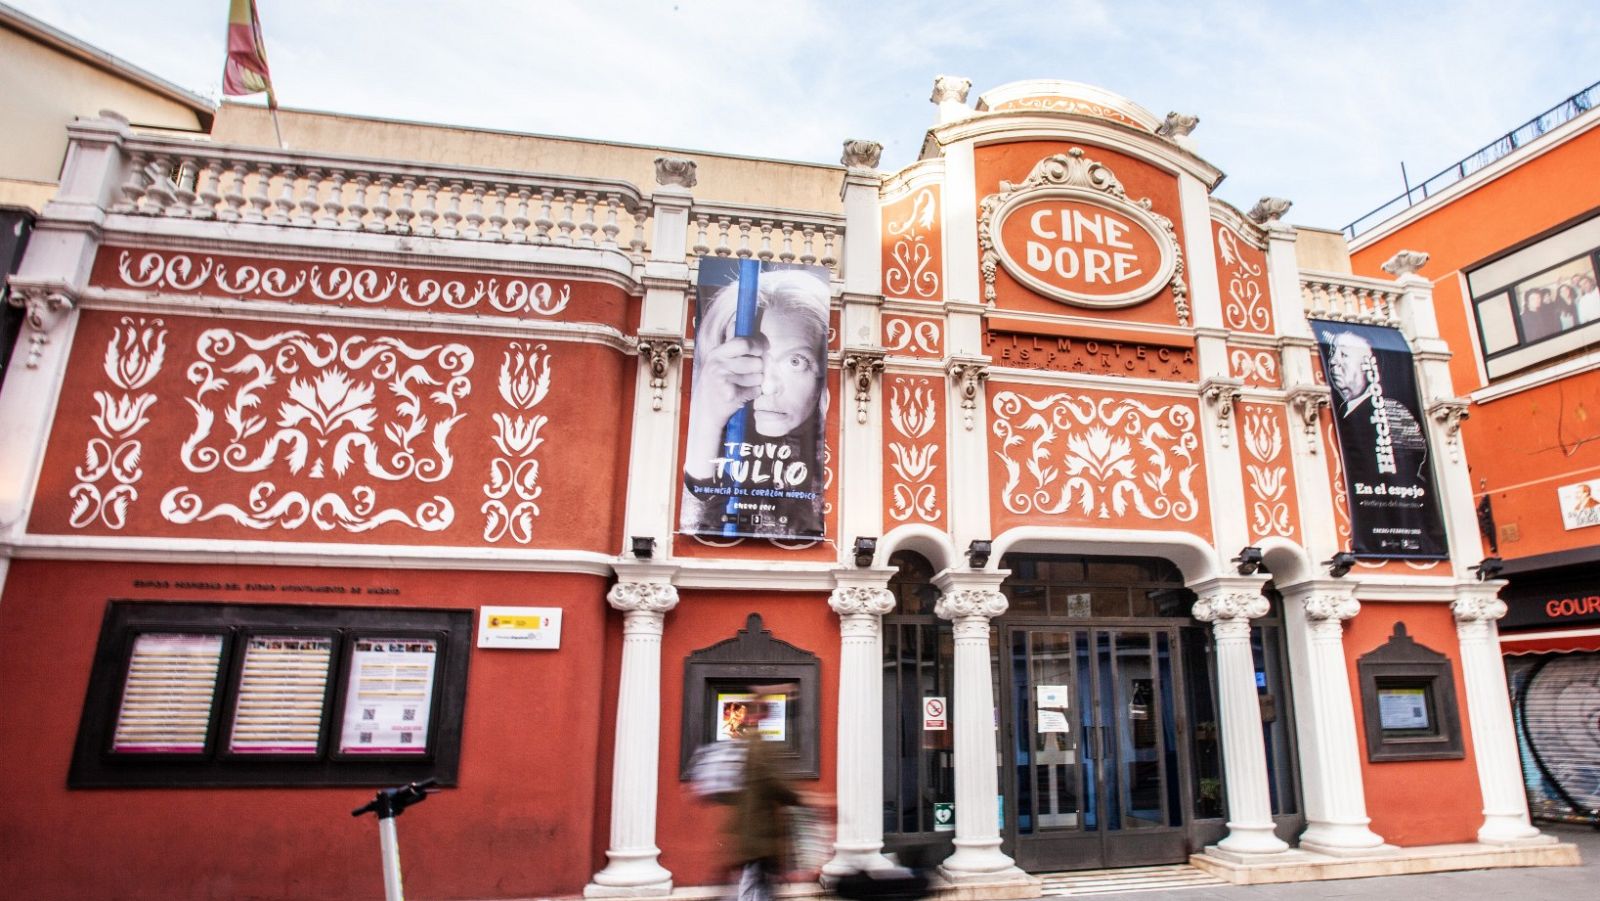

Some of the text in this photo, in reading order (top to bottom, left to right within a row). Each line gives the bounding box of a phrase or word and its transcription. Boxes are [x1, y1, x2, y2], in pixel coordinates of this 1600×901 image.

[1030, 209, 1133, 249] CINE
[1026, 240, 1143, 285] DORE
[985, 332, 1194, 364] FILMOTECA
[1001, 349, 1182, 375] ESPAÑOLA
[724, 442, 792, 460] TEUVO
[709, 457, 808, 489] TULIO
[1354, 482, 1425, 499] En el espejo
[1545, 595, 1600, 617] GOUR
